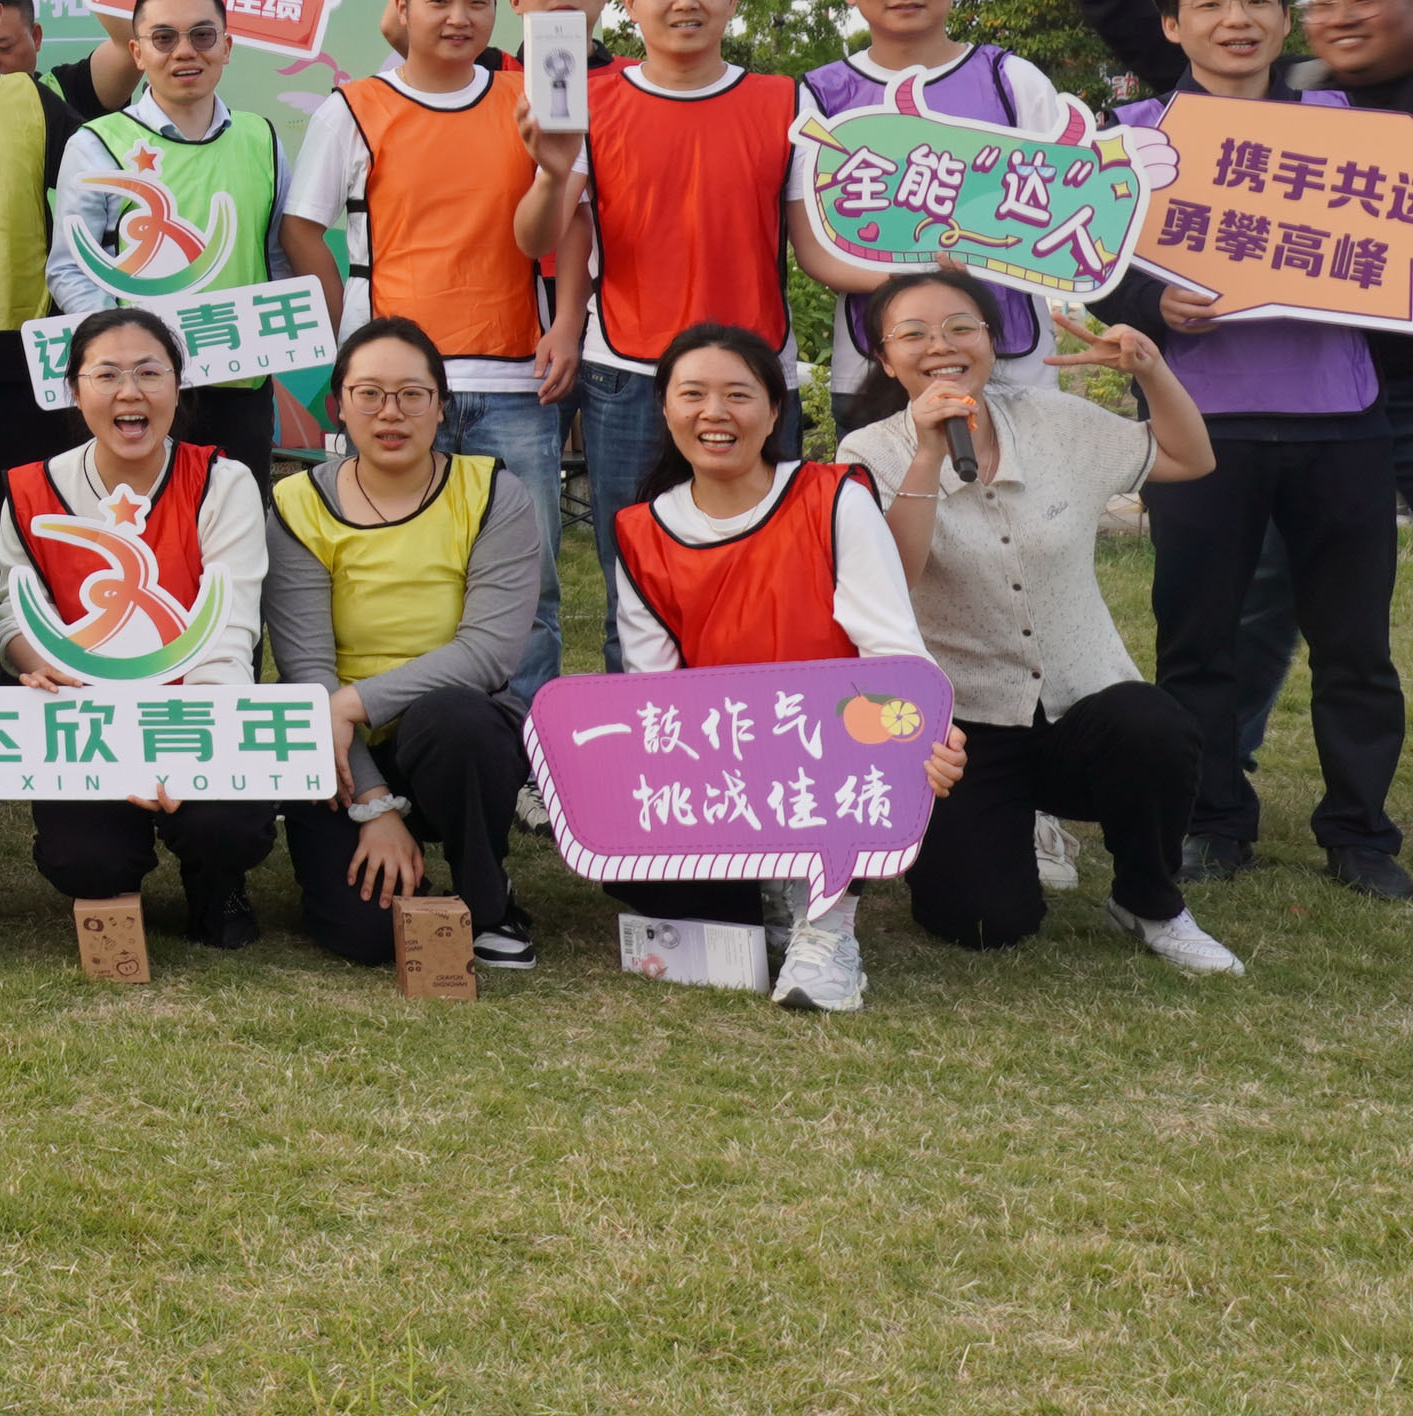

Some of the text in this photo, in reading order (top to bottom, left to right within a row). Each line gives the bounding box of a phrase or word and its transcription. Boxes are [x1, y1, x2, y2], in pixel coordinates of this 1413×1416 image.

[1157, 197, 1389, 290] 勇攀高峰
[33, 290, 318, 381] 达青年
[572, 691, 823, 761] 一鼓作气
[156, 775, 320, 791] YOUTH
[633, 764, 893, 831] 挑战佳绩
